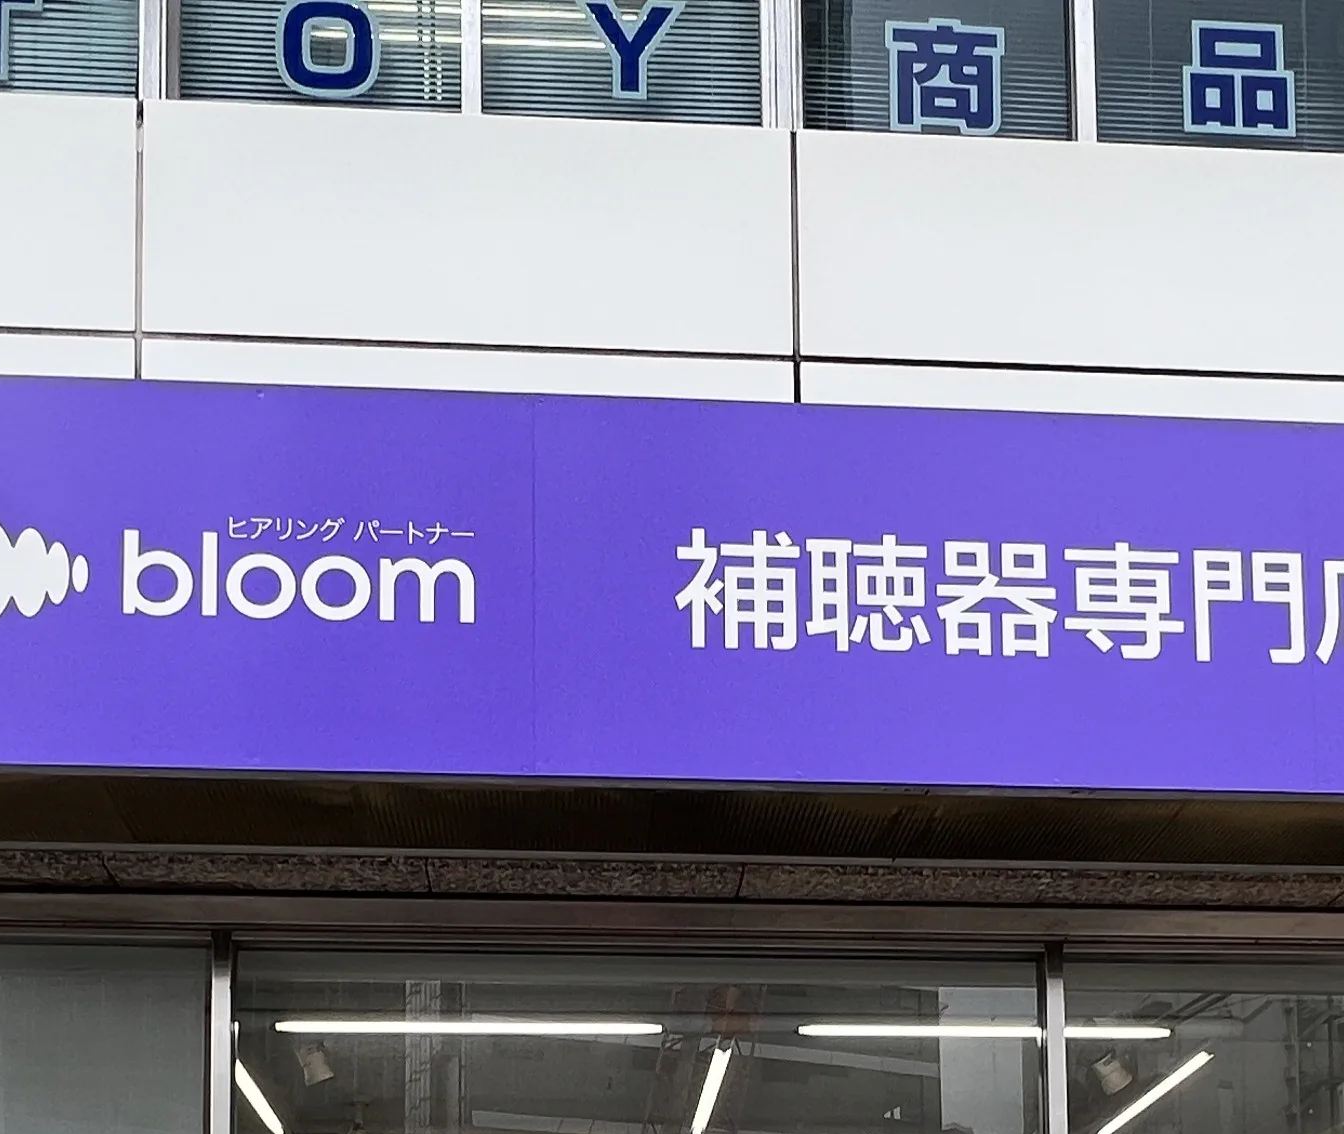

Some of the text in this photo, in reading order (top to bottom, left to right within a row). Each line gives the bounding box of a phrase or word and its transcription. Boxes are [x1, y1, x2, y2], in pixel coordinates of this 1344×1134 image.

[228, 515, 475, 546] ヒアリング パートナー
[122, 528, 476, 624] bloom
